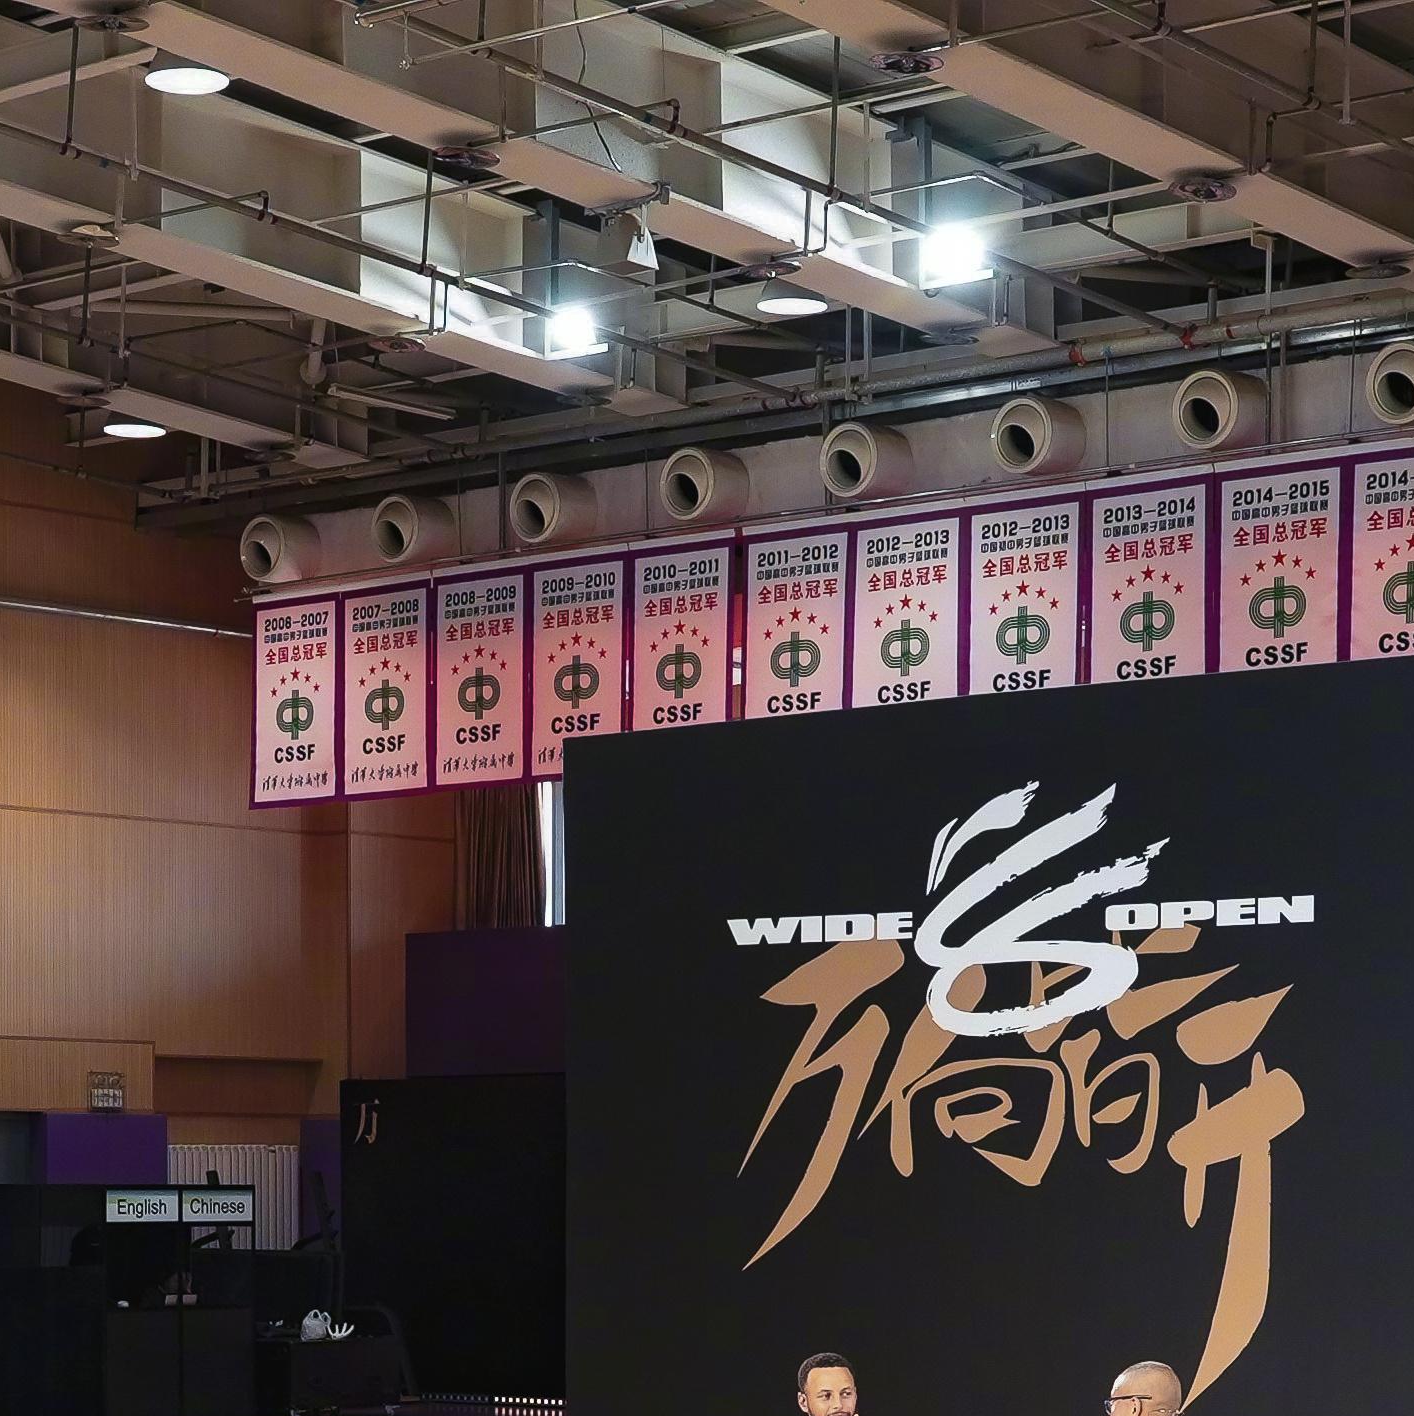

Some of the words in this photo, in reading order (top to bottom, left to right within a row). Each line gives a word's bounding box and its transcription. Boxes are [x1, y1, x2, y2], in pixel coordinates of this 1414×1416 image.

[1232, 480, 1329, 506] 2014-2015
[1103, 497, 1196, 524] 2013-2014
[981, 514, 1069, 540] 2012-2013
[1233, 517, 1328, 547] 全国总冠军
[866, 530, 950, 554] 2012-2013
[1104, 533, 1194, 563] 全国总冠军
[757, 544, 838, 568] 2011-2012
[982, 550, 1068, 578] 全国总冠军
[643, 558, 719, 581] 2010-2011
[868, 564, 947, 592] 全国总冠军
[758, 579, 838, 604] 全国总冠军
[644, 592, 718, 617] 全国总冠军
[542, 605, 614, 630] 全国总冠军
[354, 630, 418, 654] 全国总冠军
[446, 618, 515, 642] 全国总冠军
[265, 642, 327, 665] 全国总冠军
[1245, 642, 1309, 667] CSSF
[1116, 655, 1177, 680] CSSF
[877, 681, 931, 703] CSSF
[992, 669, 1051, 692] CSSF
[653, 703, 703, 724] CSSF
[767, 692, 821, 714] CSSF
[456, 724, 501, 745] CSSF
[551, 713, 601, 734] CSSF
[274, 744, 315, 763] CSSF
[362, 734, 406, 755] CSSF
[727, 912, 913, 945] WIDE
[1105, 895, 1314, 930] OPEN
[117, 1199, 167, 1218] English
[190, 1198, 245, 1214] Chinese
